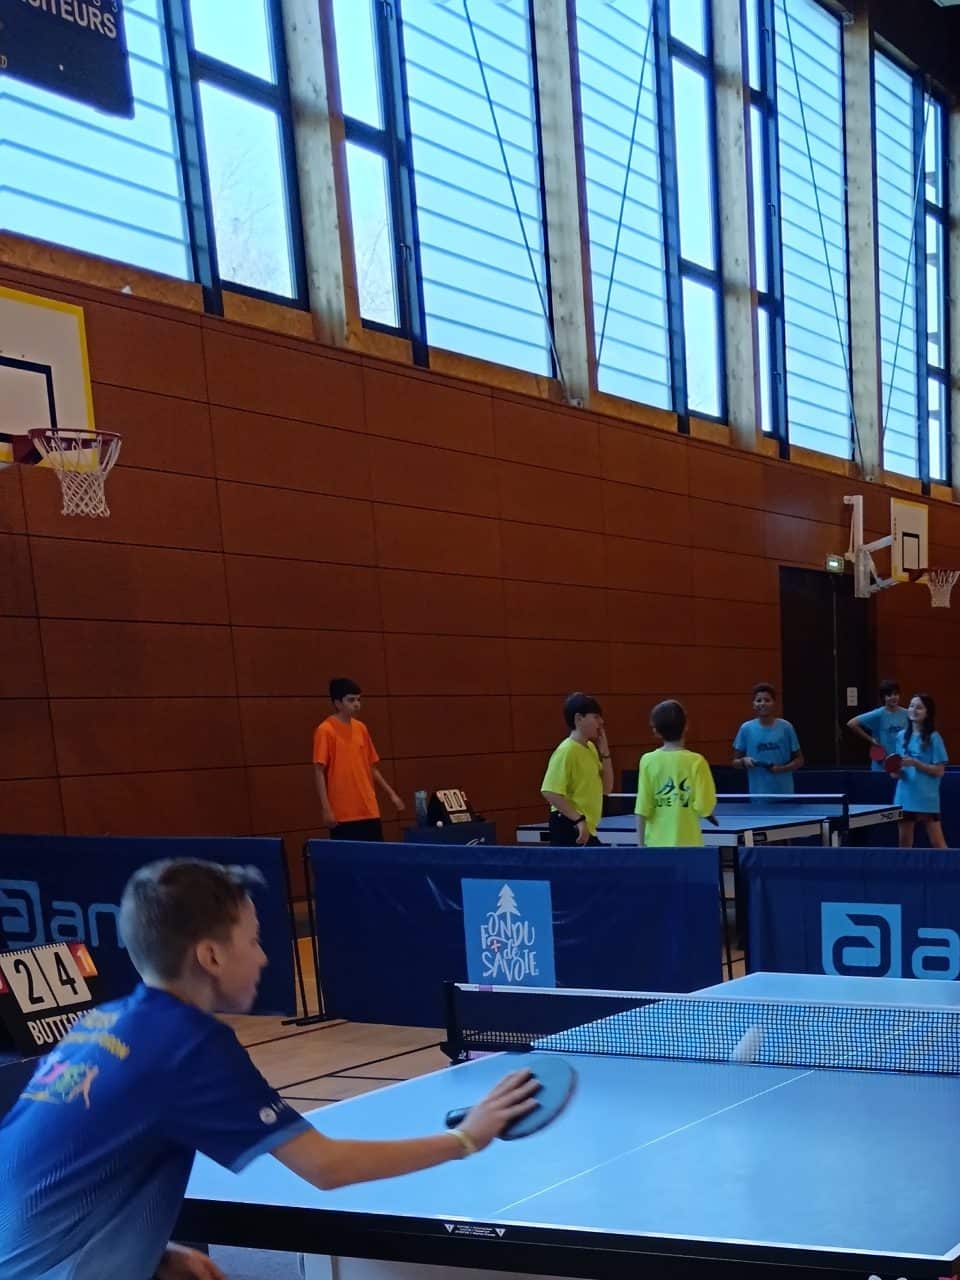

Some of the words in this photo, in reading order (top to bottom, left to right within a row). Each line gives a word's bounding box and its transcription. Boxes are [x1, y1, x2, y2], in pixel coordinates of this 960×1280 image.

[480, 912, 535, 949] FONDU
[482, 949, 540, 982] SAVOIE
[27, 1009, 93, 1046] BUTTE
